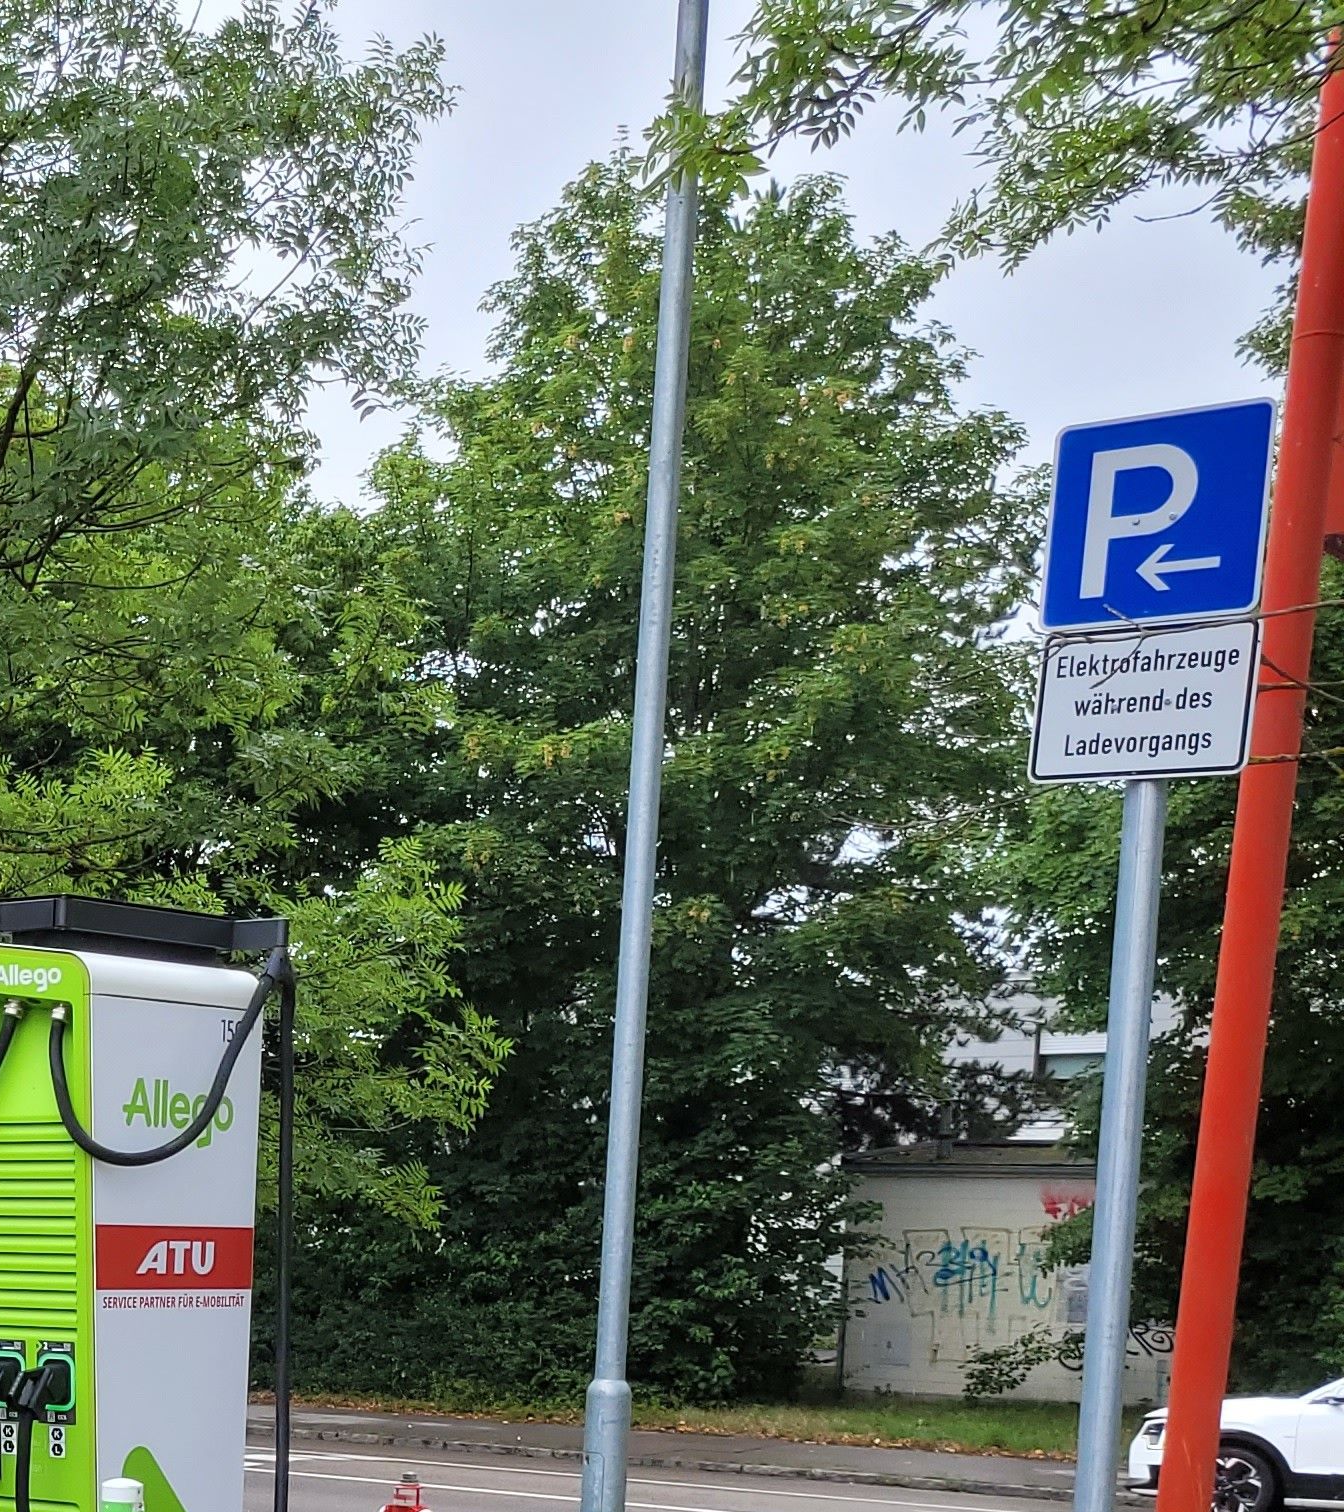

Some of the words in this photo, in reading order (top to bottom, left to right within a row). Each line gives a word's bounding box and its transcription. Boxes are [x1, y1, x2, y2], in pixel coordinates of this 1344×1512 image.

[1079, 443, 1199, 599] P
[1056, 648, 1240, 679] Elektrofahrzeuge
[1074, 688, 1165, 717] während
[1175, 687, 1213, 710] des
[1064, 732, 1213, 758] Ladevorgangs
[220, 1019, 242, 1043] 15
[135, 1240, 215, 1276] ATU
[102, 1296, 137, 1309] SERVICE
[139, 1296, 176, 1308] PARTNER
[178, 1293, 194, 1308] FÜR
[195, 1292, 245, 1308] E-MOBILITÄT
